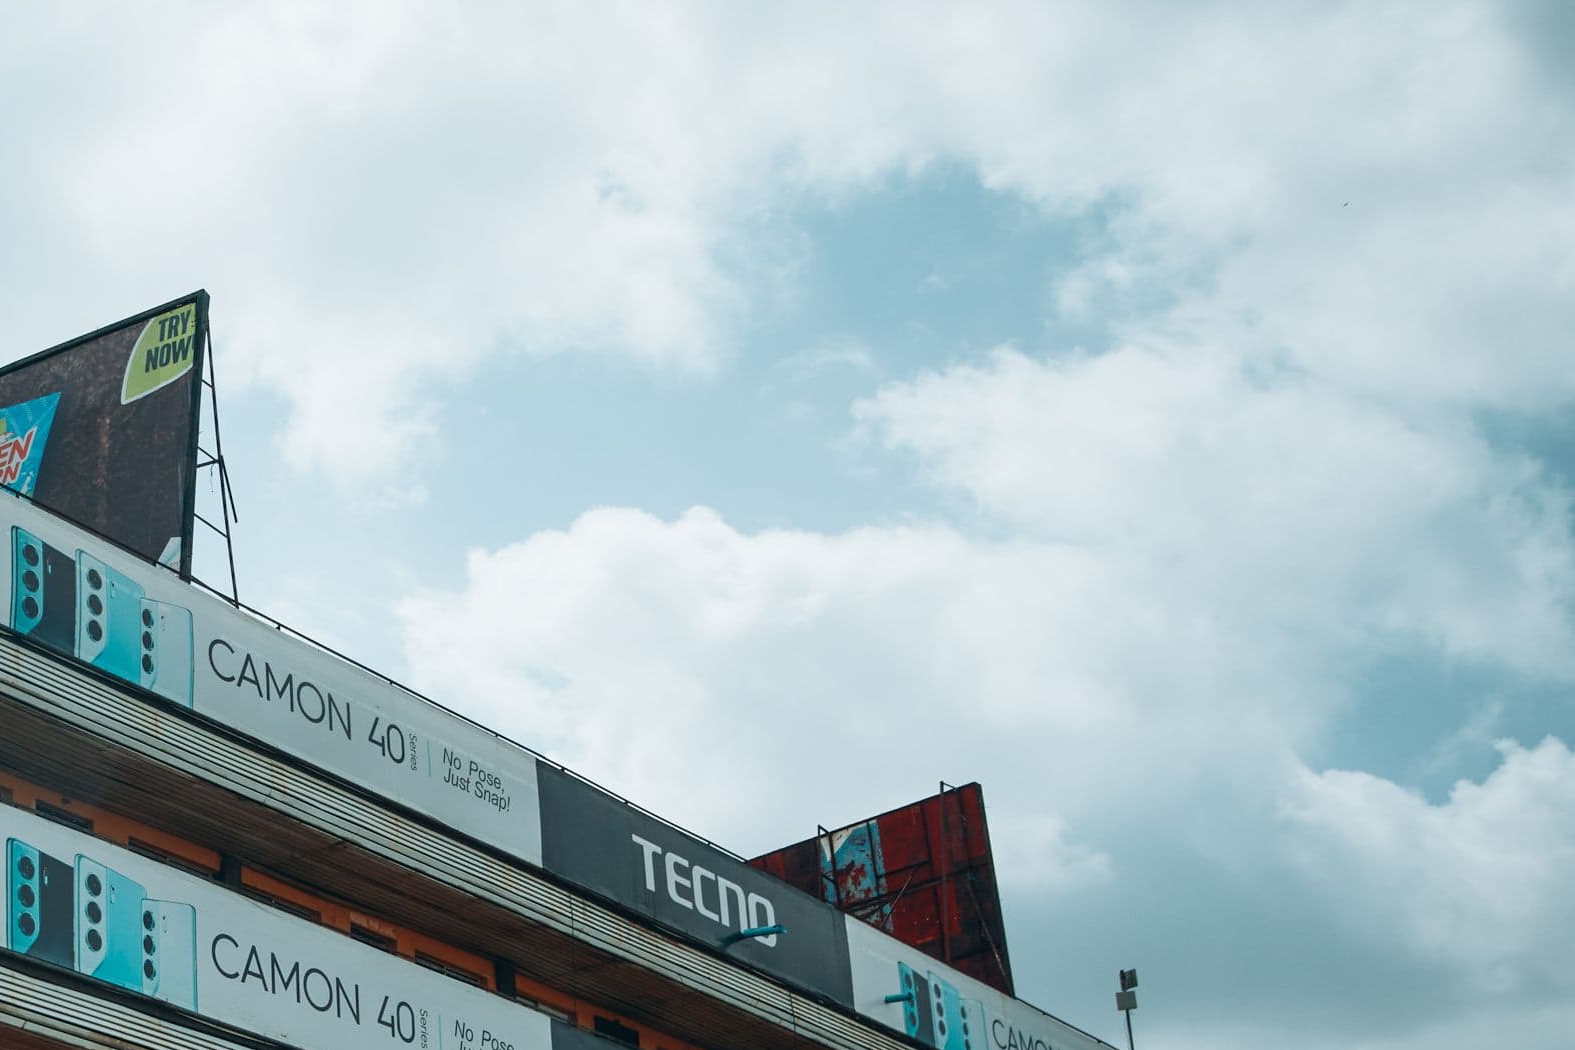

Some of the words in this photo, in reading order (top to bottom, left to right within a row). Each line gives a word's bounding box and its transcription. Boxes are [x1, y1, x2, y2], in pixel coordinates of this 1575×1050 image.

[158, 309, 191, 342] TRY
[207, 639, 352, 741] CAMON
[368, 716, 405, 766] 40
[407, 732, 418, 772] Series
[442, 747, 462, 772] No
[468, 760, 505, 794] Pose,
[442, 767, 470, 794] Just
[474, 782, 511, 813] Snap!
[631, 833, 777, 948] TECNO
[211, 934, 361, 1026] CAMON
[377, 995, 416, 1044] 40
[418, 1008, 429, 1049] Series
[455, 1020, 474, 1042] No
